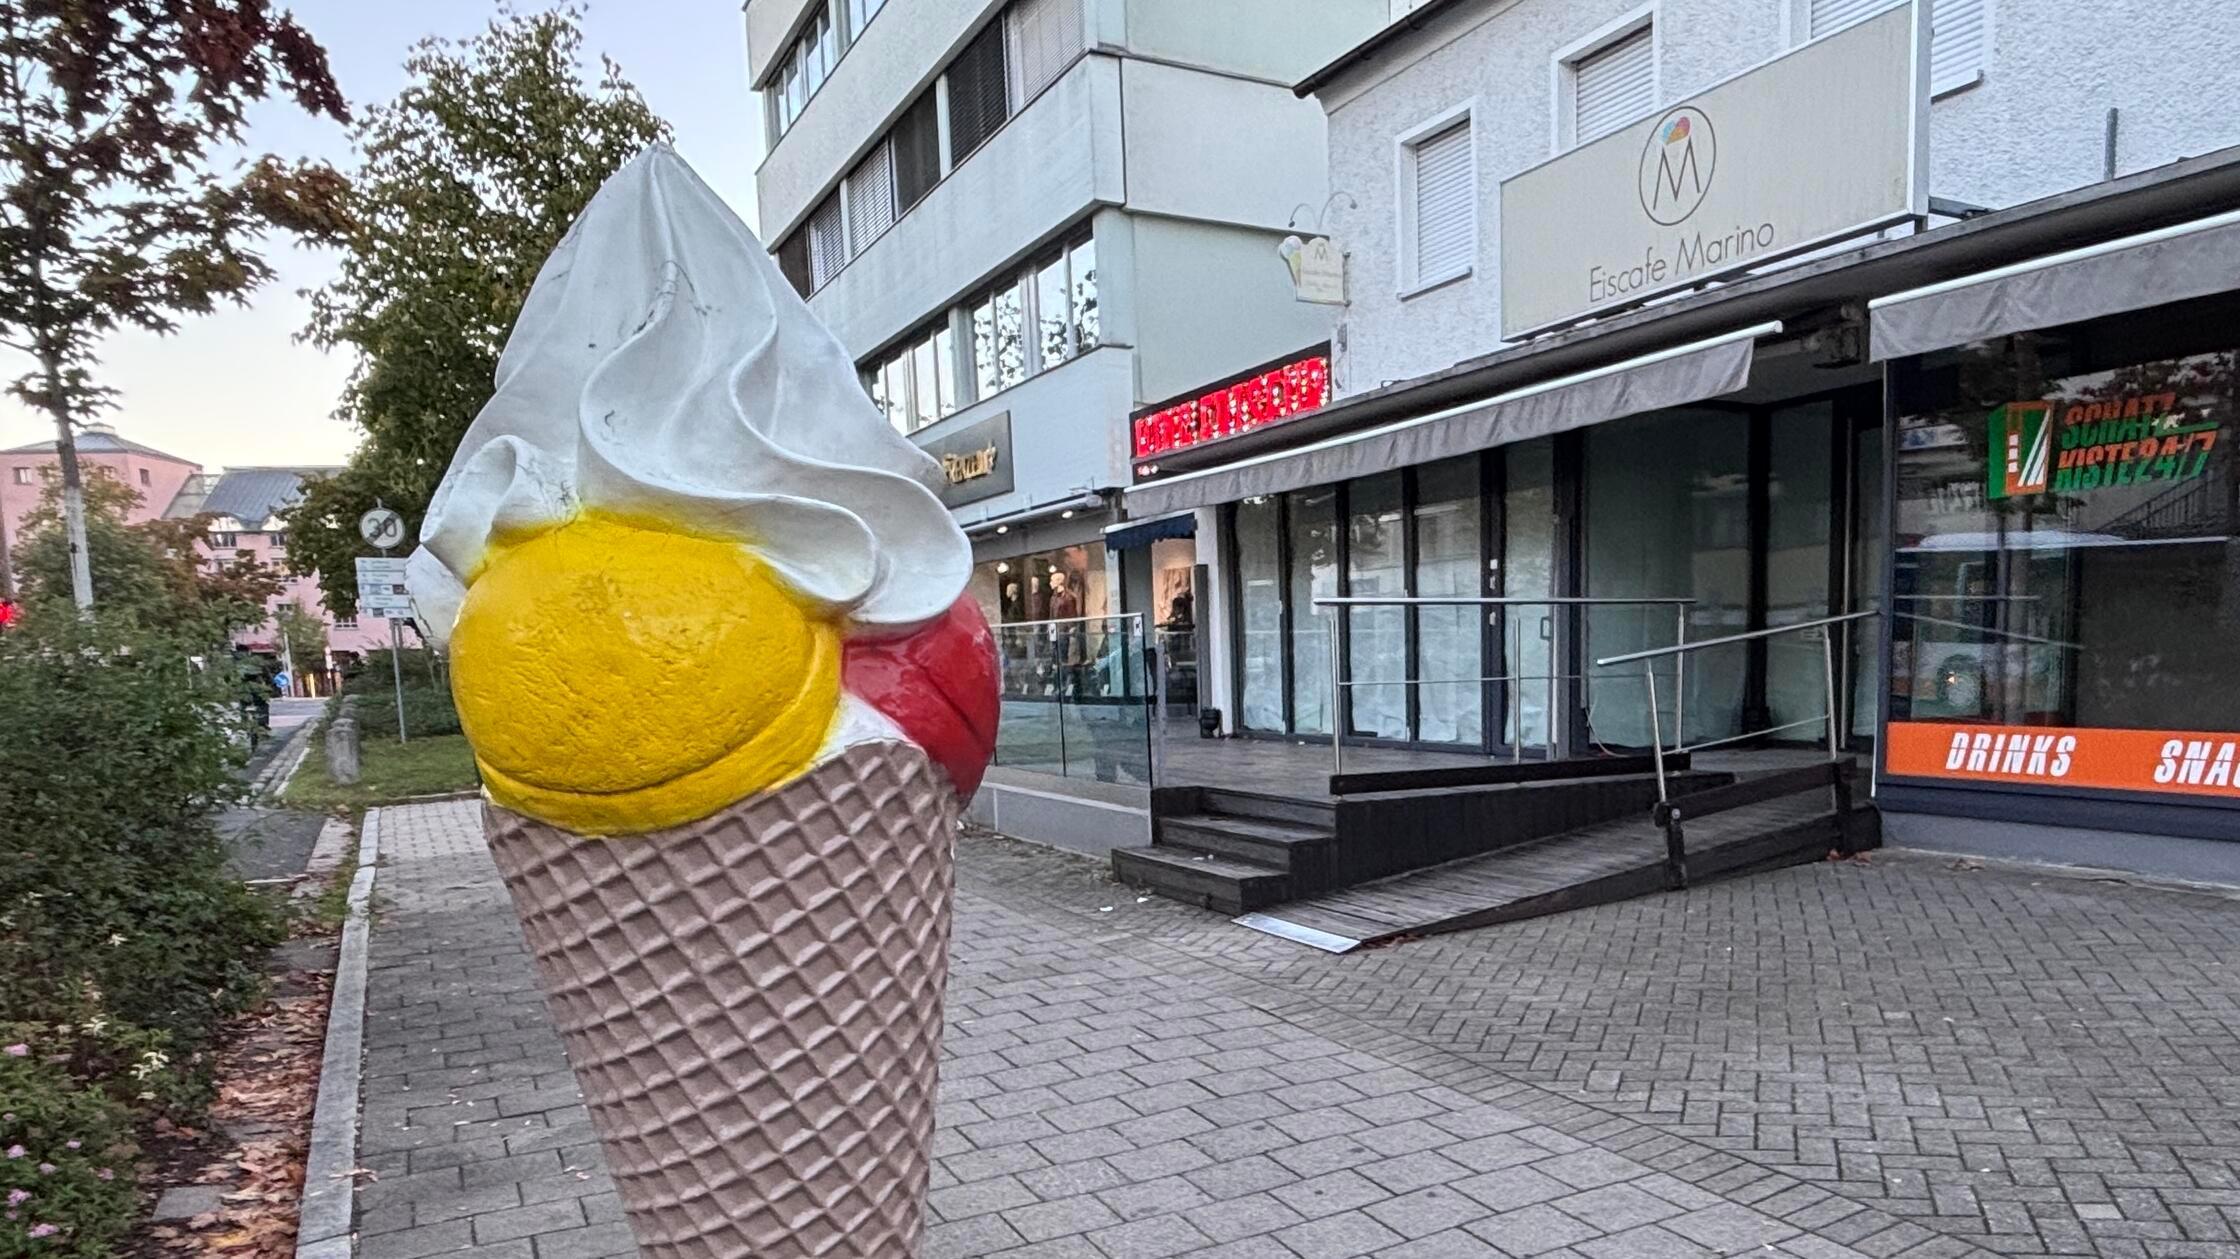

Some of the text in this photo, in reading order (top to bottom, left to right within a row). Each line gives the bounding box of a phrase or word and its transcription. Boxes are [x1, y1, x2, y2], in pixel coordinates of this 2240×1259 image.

[1652, 136, 1701, 210] M
[1589, 222, 1775, 302] Eiscafe Marino
[367, 517, 397, 538] 30
[1945, 732, 2077, 777] DRINKS
